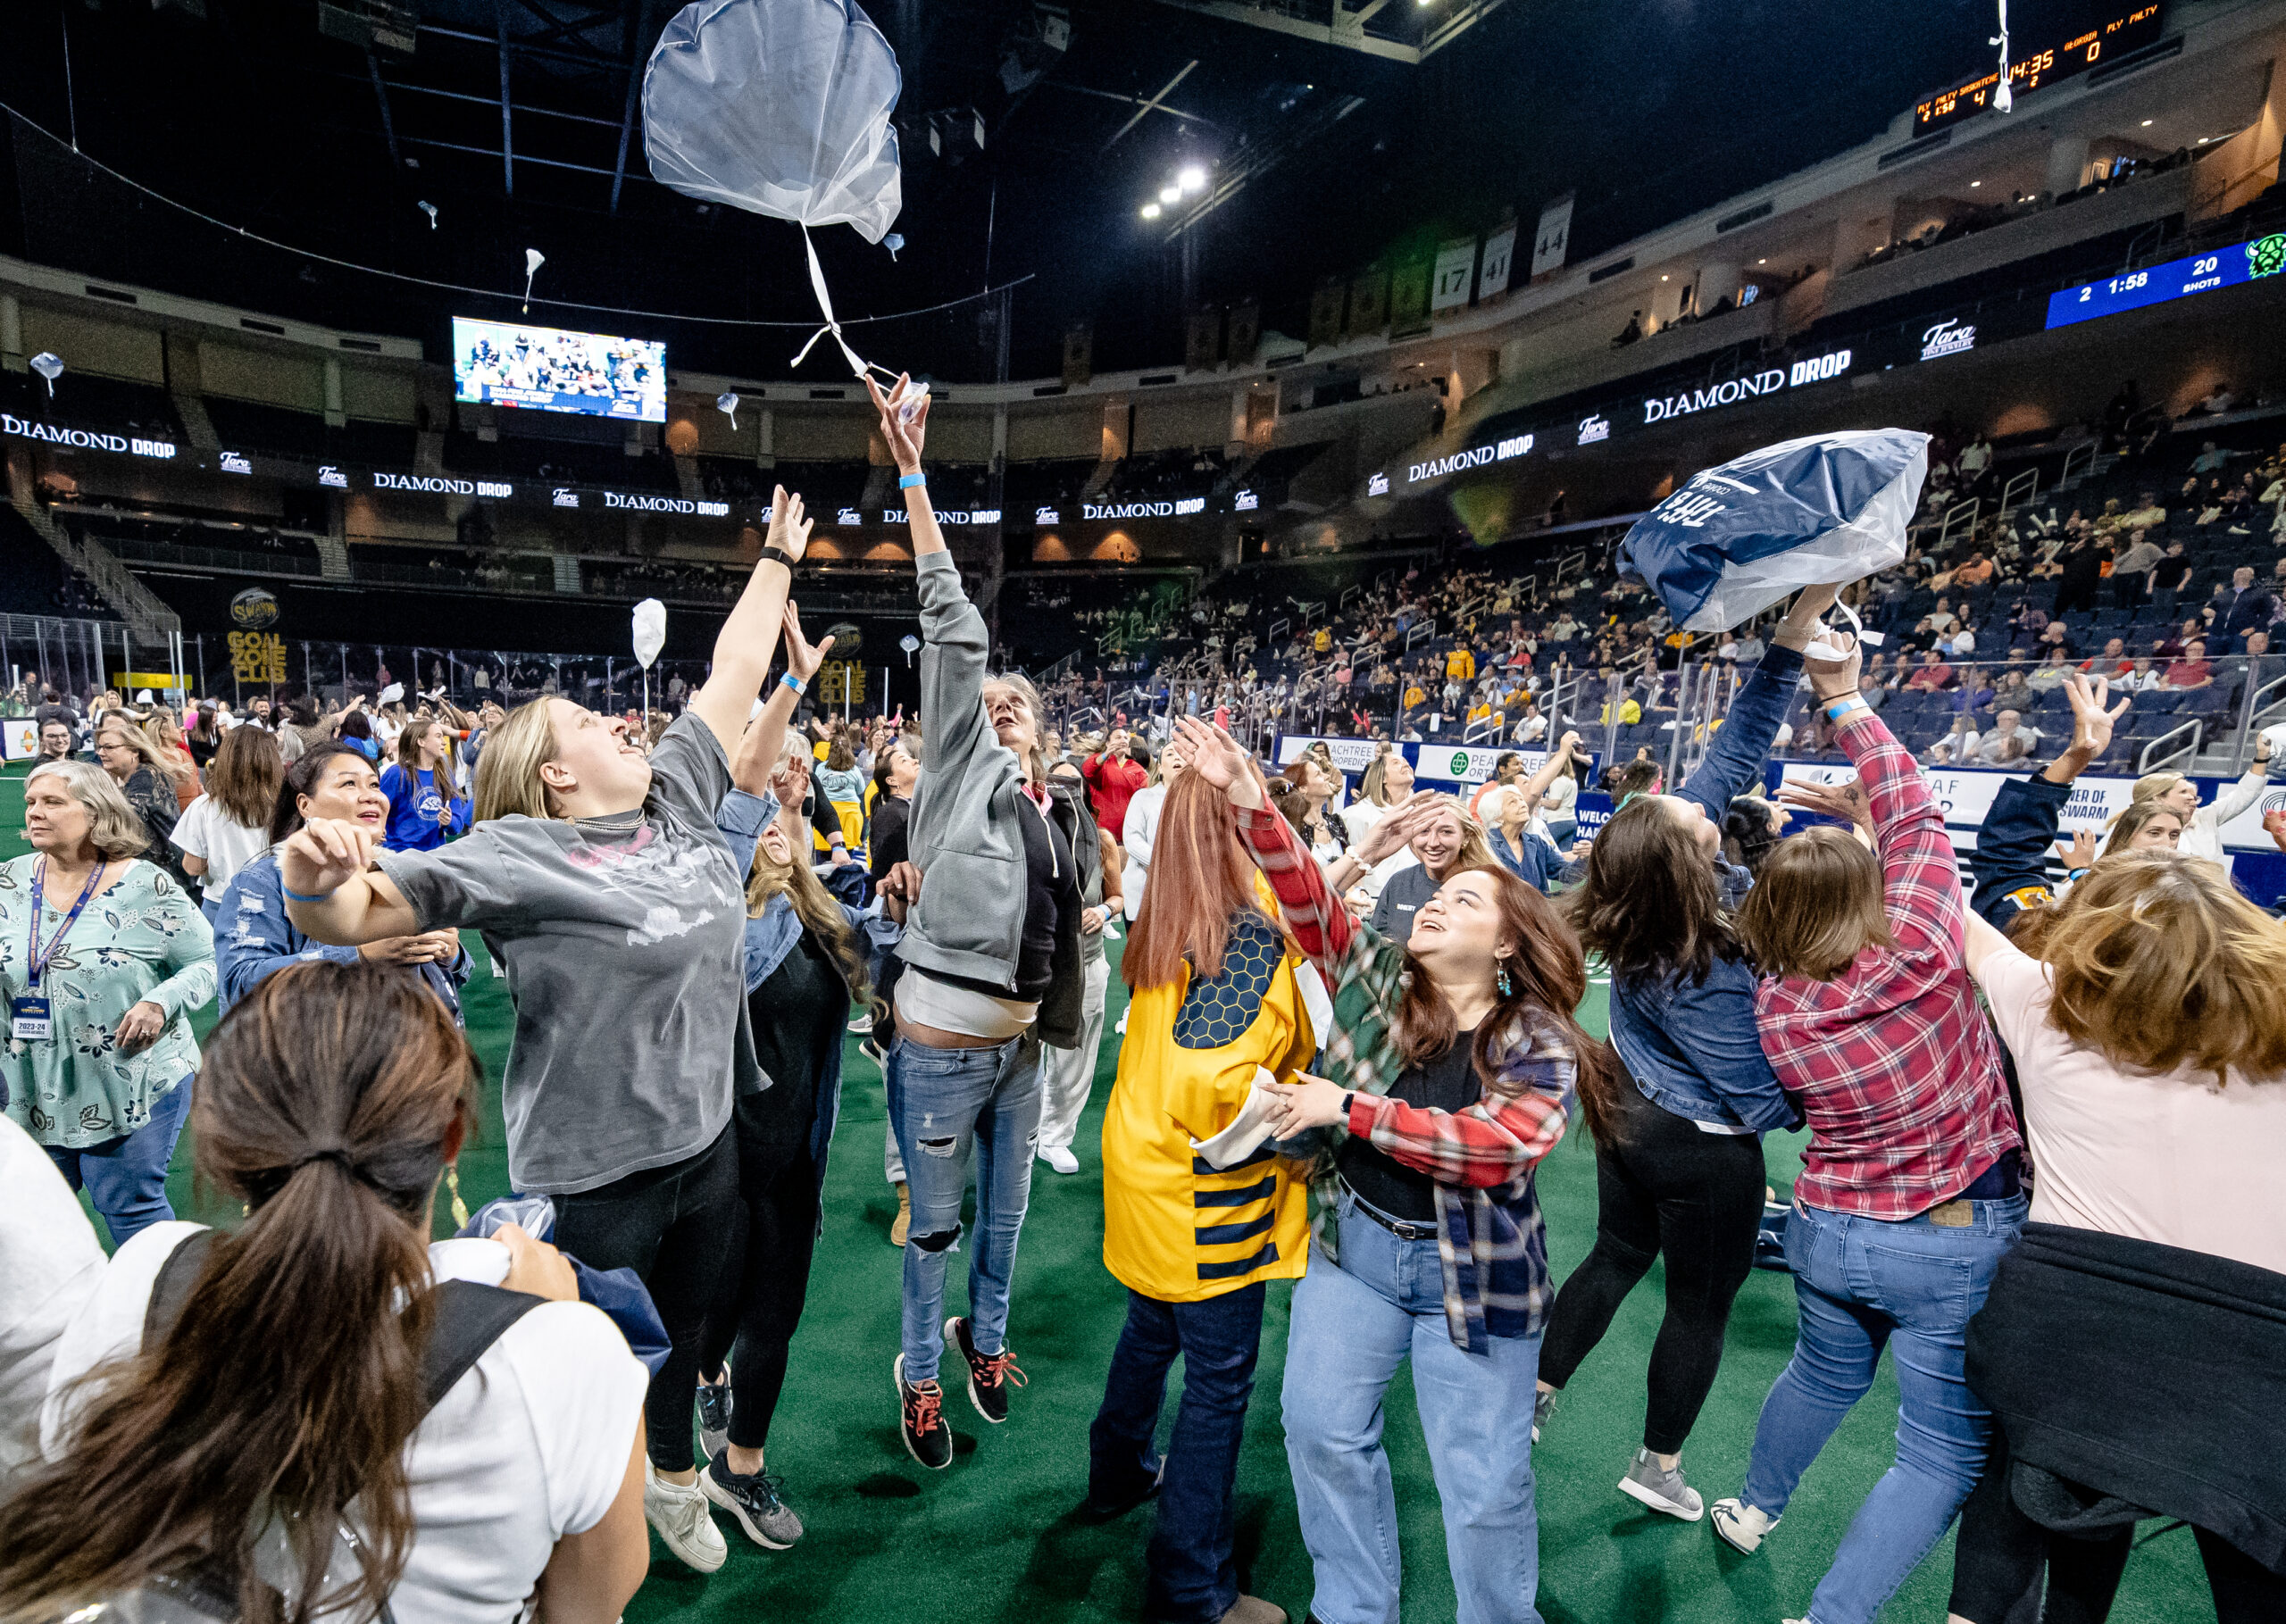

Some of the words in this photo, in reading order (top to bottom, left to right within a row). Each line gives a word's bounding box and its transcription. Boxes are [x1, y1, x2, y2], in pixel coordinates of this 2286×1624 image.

[2107, 19, 2123, 34] PLY
[2129, 4, 2157, 26] PNLTY
[2064, 30, 2098, 52] GEORGIA
[2086, 41, 2100, 62] 0
[2009, 49, 2054, 83] 14:35
[2030, 75, 2040, 87] 2
[1917, 101, 1931, 114] PLY
[1935, 90, 1957, 106] PNLTY
[1974, 90, 1986, 105] 4
[1935, 100, 1956, 116] 1:58
[2192, 256, 2218, 276] 20
[1440, 270, 1466, 296] 17
[2079, 287, 2092, 302] 2
[2108, 272, 2148, 295] 1:58
[2182, 277, 2221, 294] SHOTS
[1923, 317, 1976, 347] Tara
[1644, 369, 1785, 424] DIAMOND
[1790, 349, 1852, 387] DROP
[1579, 413, 1610, 436] Tara
[3, 414, 128, 453] DIAMOND
[131, 438, 177, 459] DROP
[220, 452, 251, 467] Tara
[1408, 446, 1495, 483] DIAMOND
[1497, 434, 1535, 462] DROP
[318, 466, 346, 481] Tara
[373, 473, 474, 495] DIAMOND
[477, 482, 513, 498] DROP
[553, 488, 579, 502] Tara
[605, 492, 695, 514] DIAMOND
[697, 501, 729, 516] DROP
[761, 506, 773, 519] Ta
[1083, 503, 1172, 520] DIAMOND
[1175, 497, 1205, 515] DROP
[883, 510, 970, 524] DIAOND
[972, 510, 1002, 524] DROP
[228, 631, 287, 651] GOAL
[229, 648, 287, 667] ZONE
[233, 664, 287, 684] CLUB
[1329, 745, 1372, 757] ACHTREE
[1471, 754, 1547, 770] PEAREE
[2091, 790, 2107, 804] OF
[1579, 810, 1611, 824] WELC
[2059, 805, 2110, 820] SWARM
[18, 1022, 46, 1031] 2023-24
